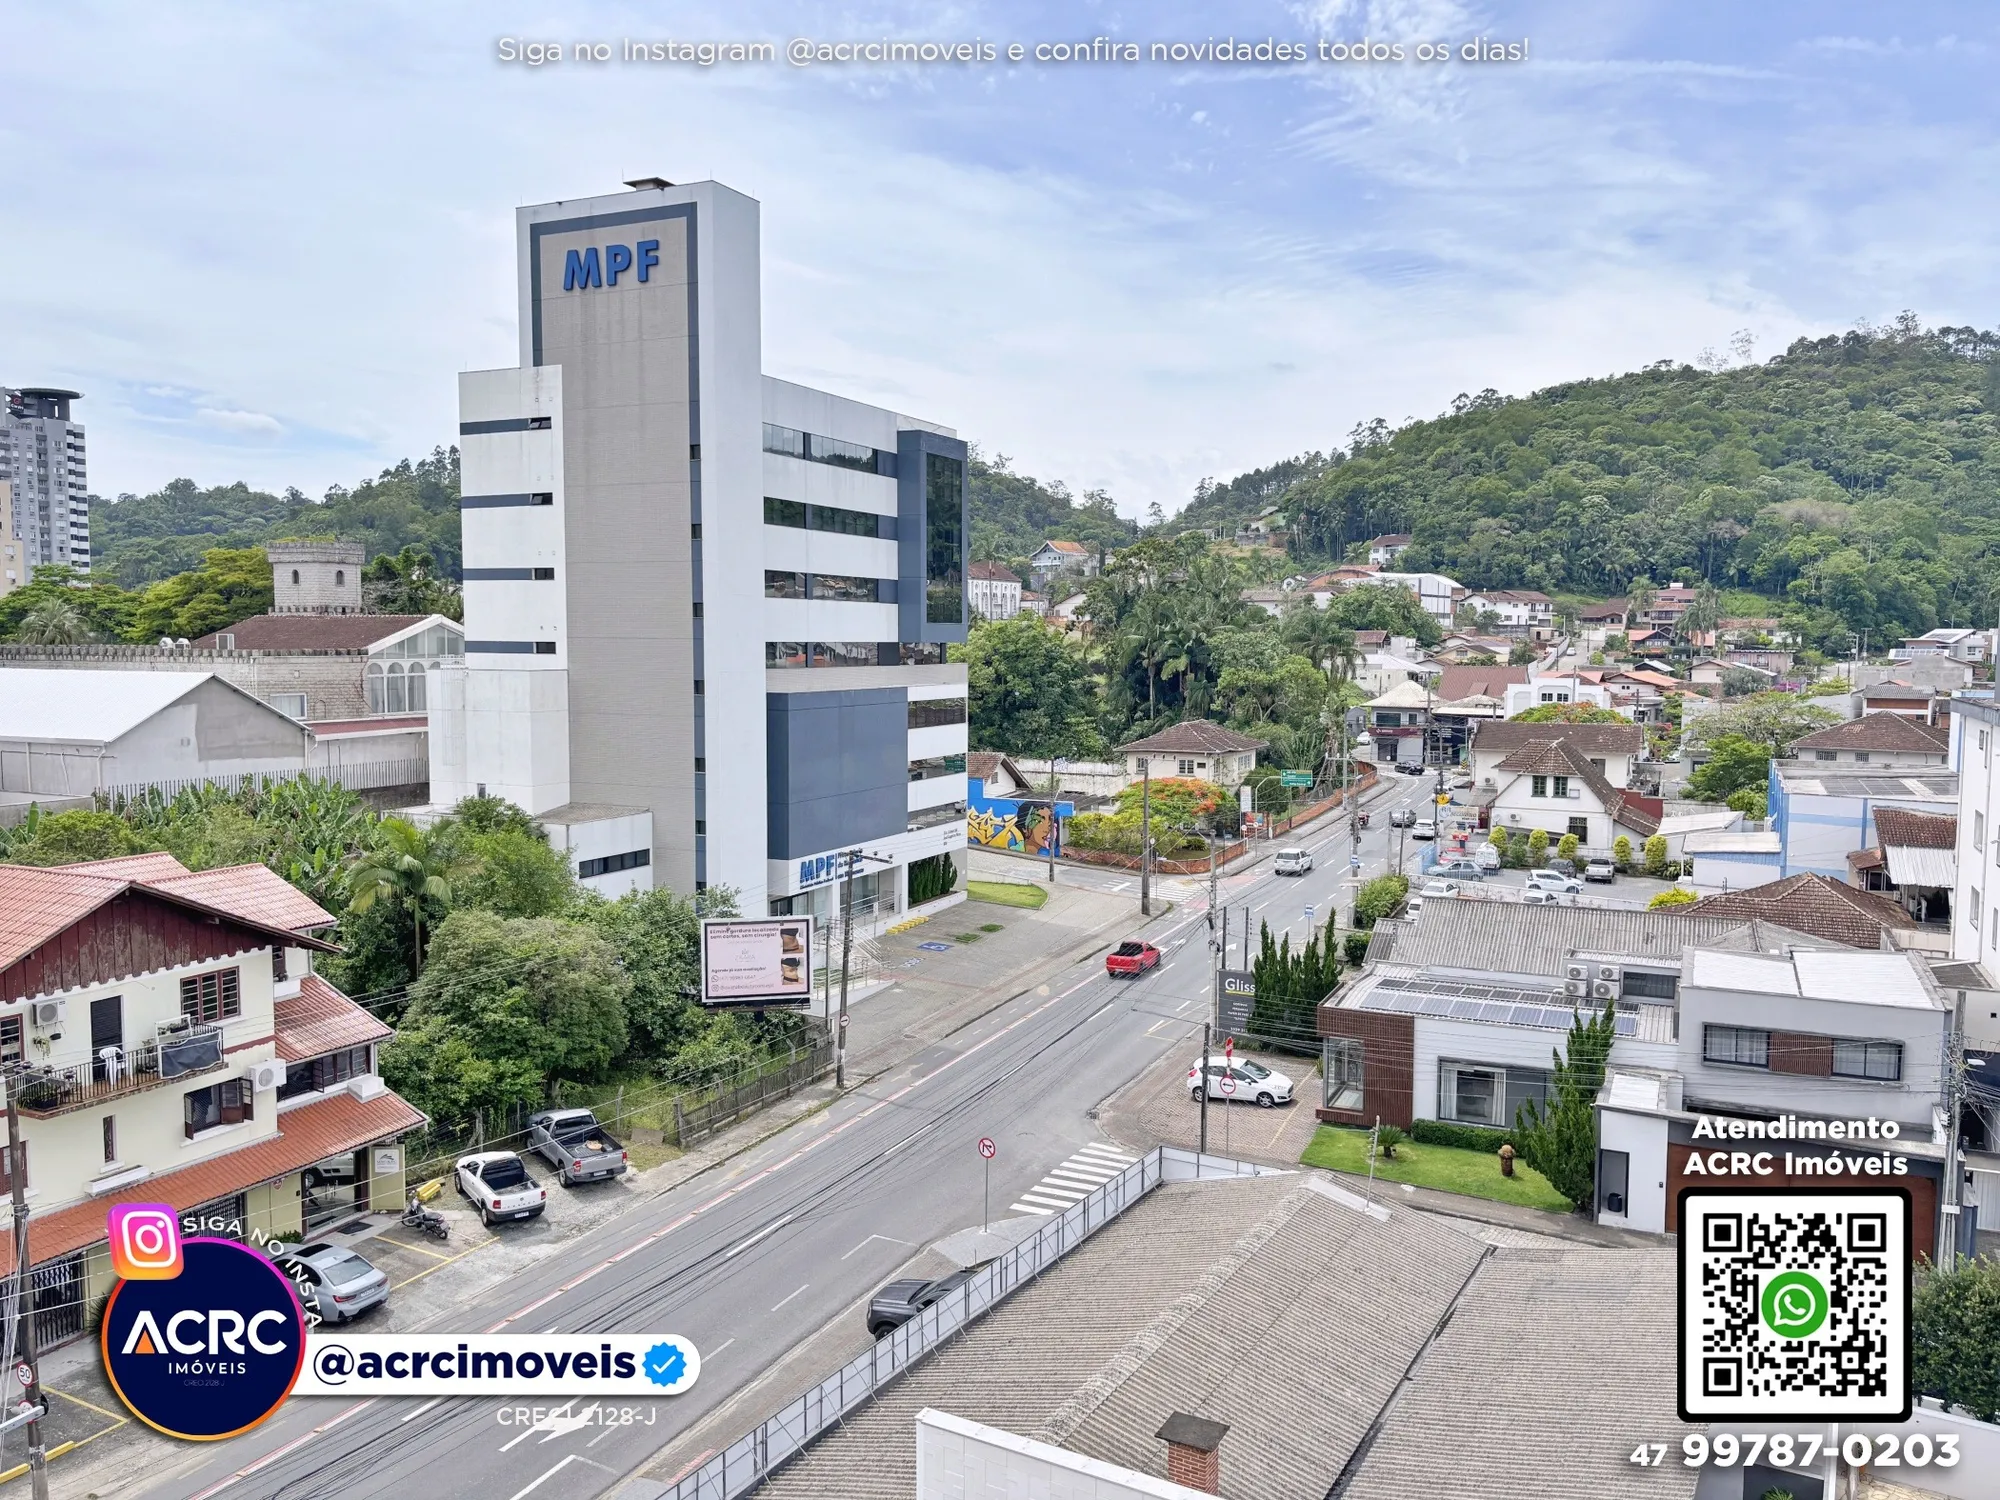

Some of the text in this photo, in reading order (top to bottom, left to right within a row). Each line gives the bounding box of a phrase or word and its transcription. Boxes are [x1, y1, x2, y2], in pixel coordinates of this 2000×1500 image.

[564, 239, 659, 291] MPF
[800, 855, 834, 883] MPF
[20, 1367, 30, 1379] 50
